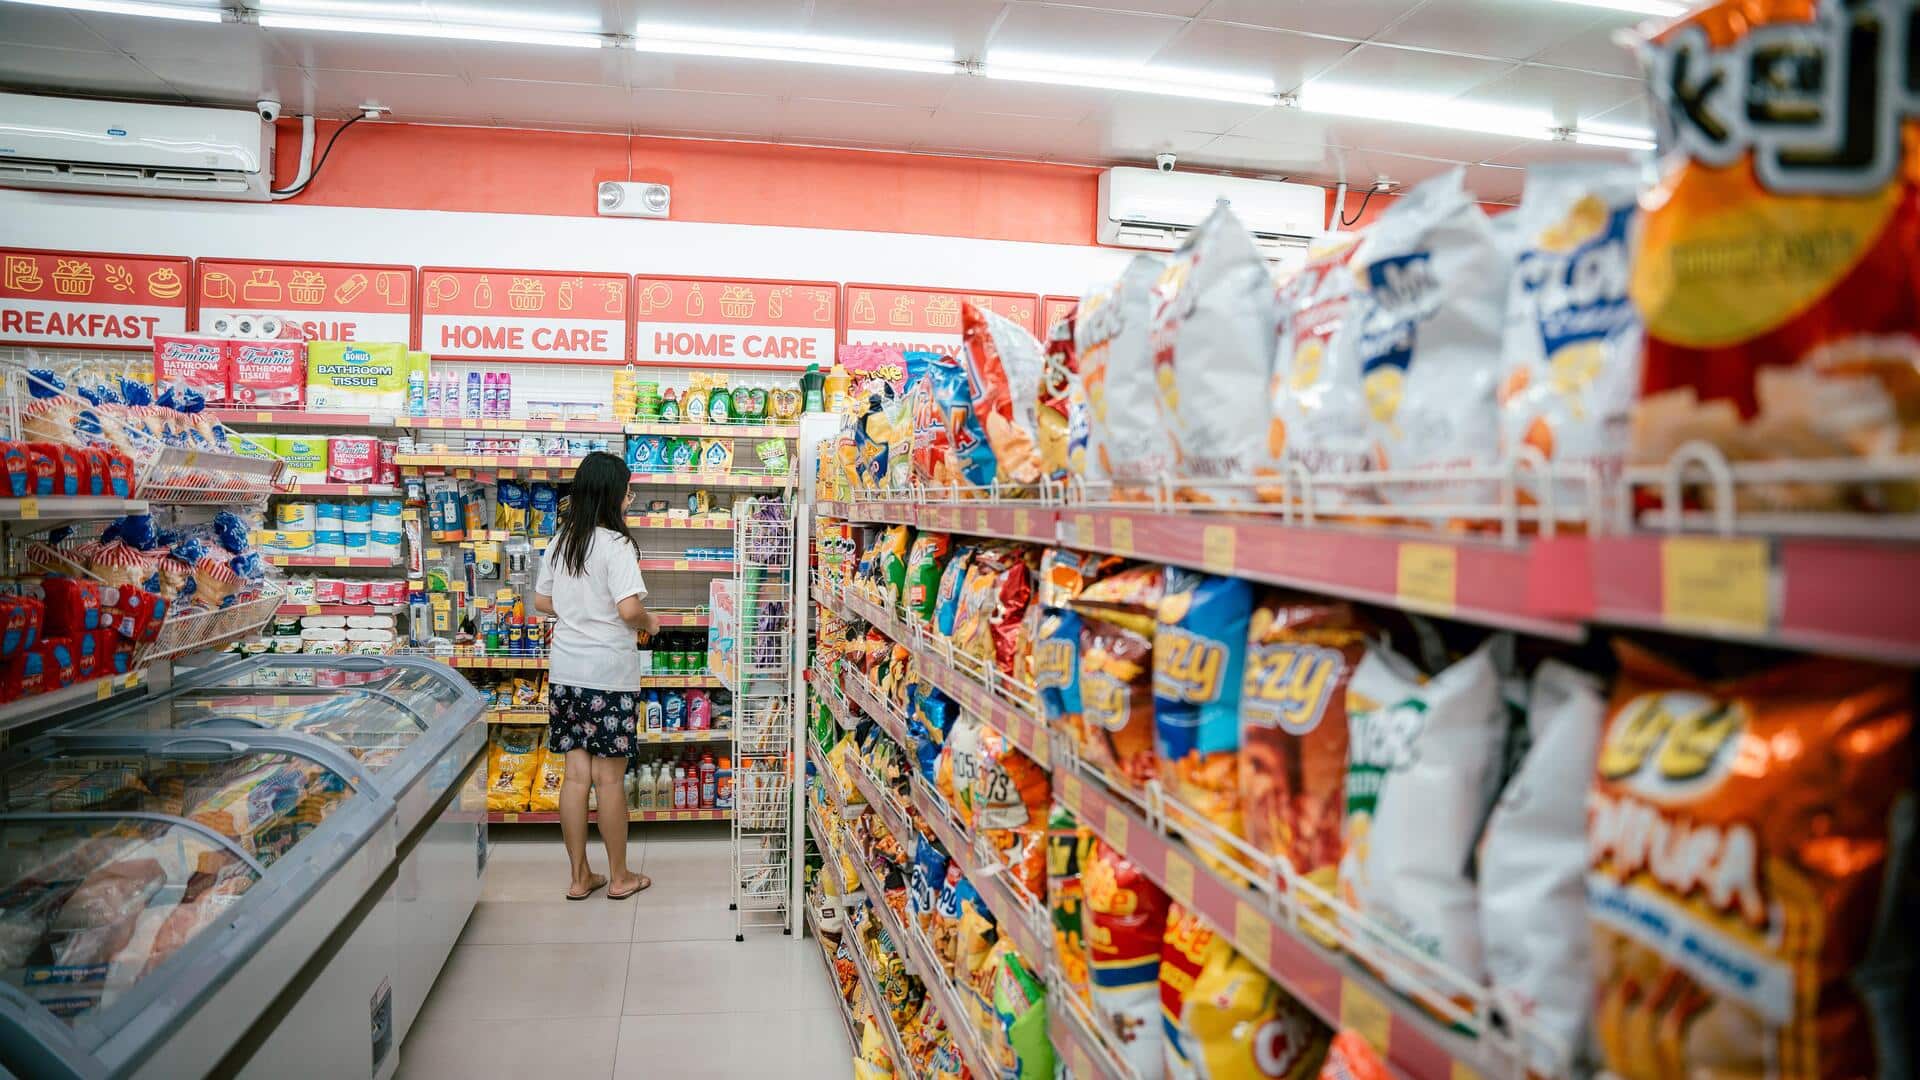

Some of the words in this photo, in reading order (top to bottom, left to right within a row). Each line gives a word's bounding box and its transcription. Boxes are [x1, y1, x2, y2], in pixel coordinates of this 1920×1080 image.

[2, 310, 160, 339] REAKFAST
[302, 321, 357, 342] SUE
[441, 325, 524, 349] HOME
[532, 328, 607, 352] CARE
[654, 332, 735, 357] HOME
[742, 335, 817, 358] CARE
[345, 353, 369, 361] BONUS
[163, 360, 218, 370] BATHROOM
[239, 365, 292, 373] BATHROOM
[317, 365, 393, 375] BATHROOM
[163, 369, 196, 377] TISUE
[239, 372, 271, 380] TISSUE
[332, 377, 377, 386] TISSUE
